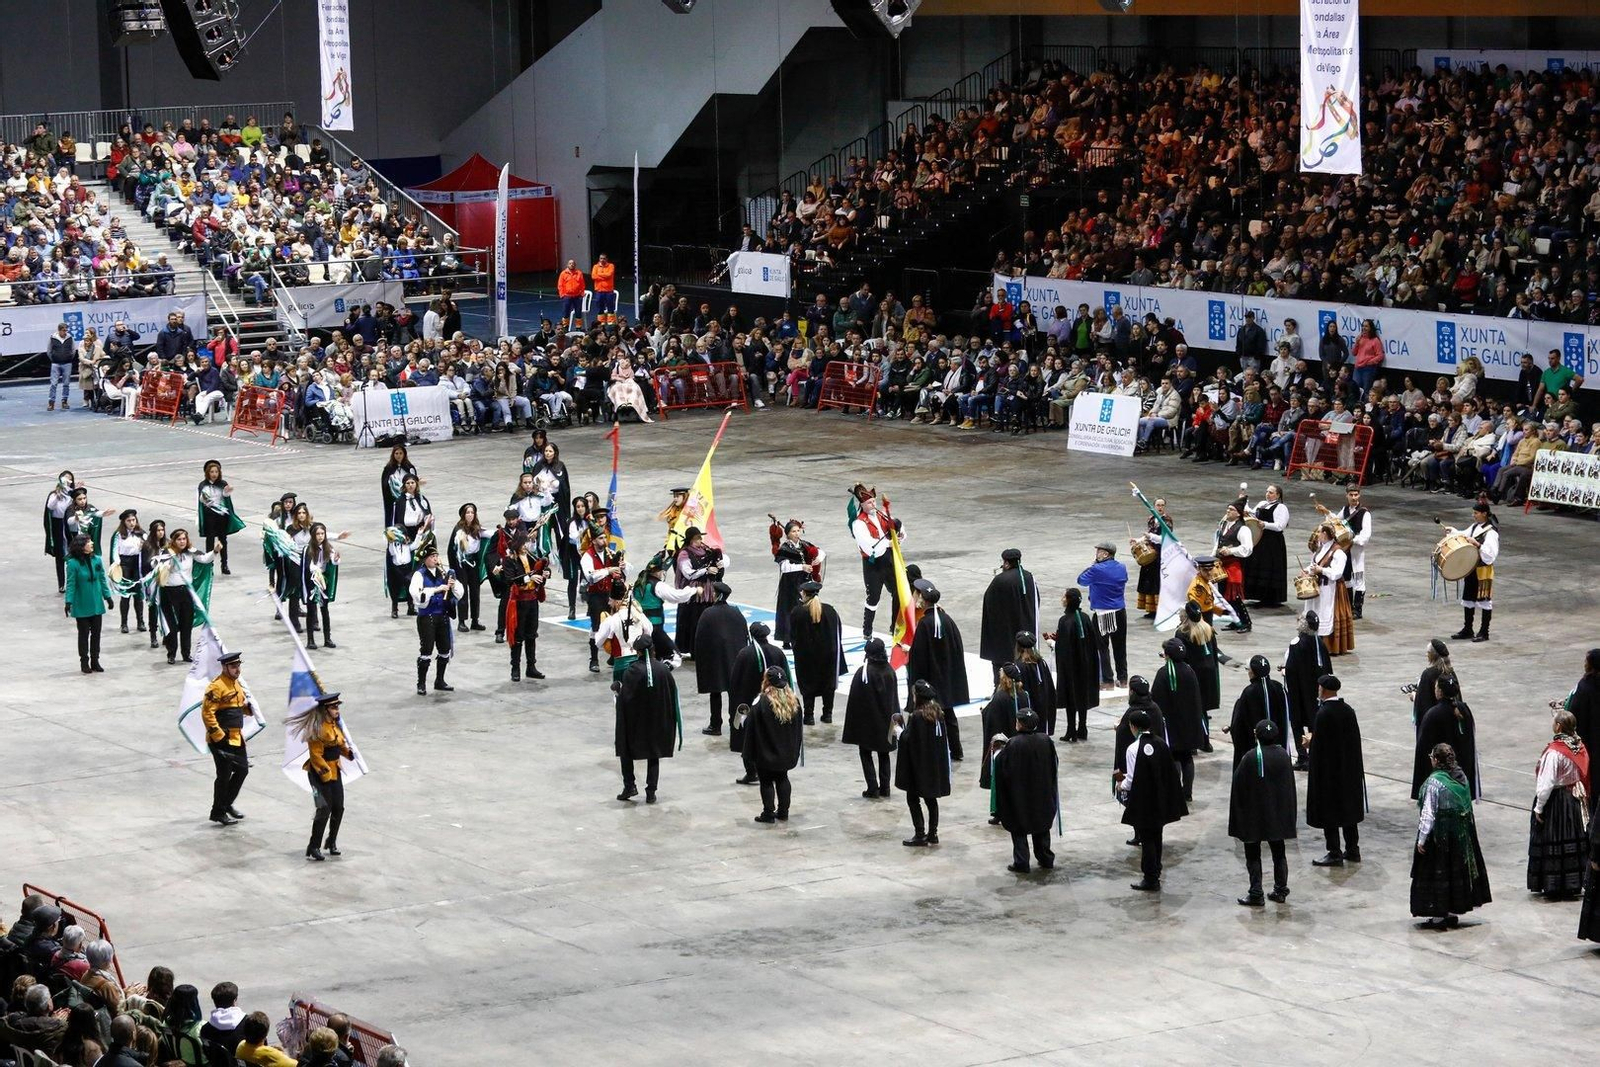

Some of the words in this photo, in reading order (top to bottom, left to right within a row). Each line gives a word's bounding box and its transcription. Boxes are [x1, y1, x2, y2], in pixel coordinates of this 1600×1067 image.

[1314, 13, 1345, 22] ondallas
[1026, 287, 1060, 303] XUNTA
[1124, 296, 1161, 313] XUNTA
[87, 311, 131, 324] XUNTA
[1461, 326, 1507, 346] XUNTA
[407, 415, 442, 426] GALICIA
[1074, 422, 1096, 433] XUNTA
[1097, 425, 1105, 435] DE
[1106, 426, 1131, 437] GALICIA
